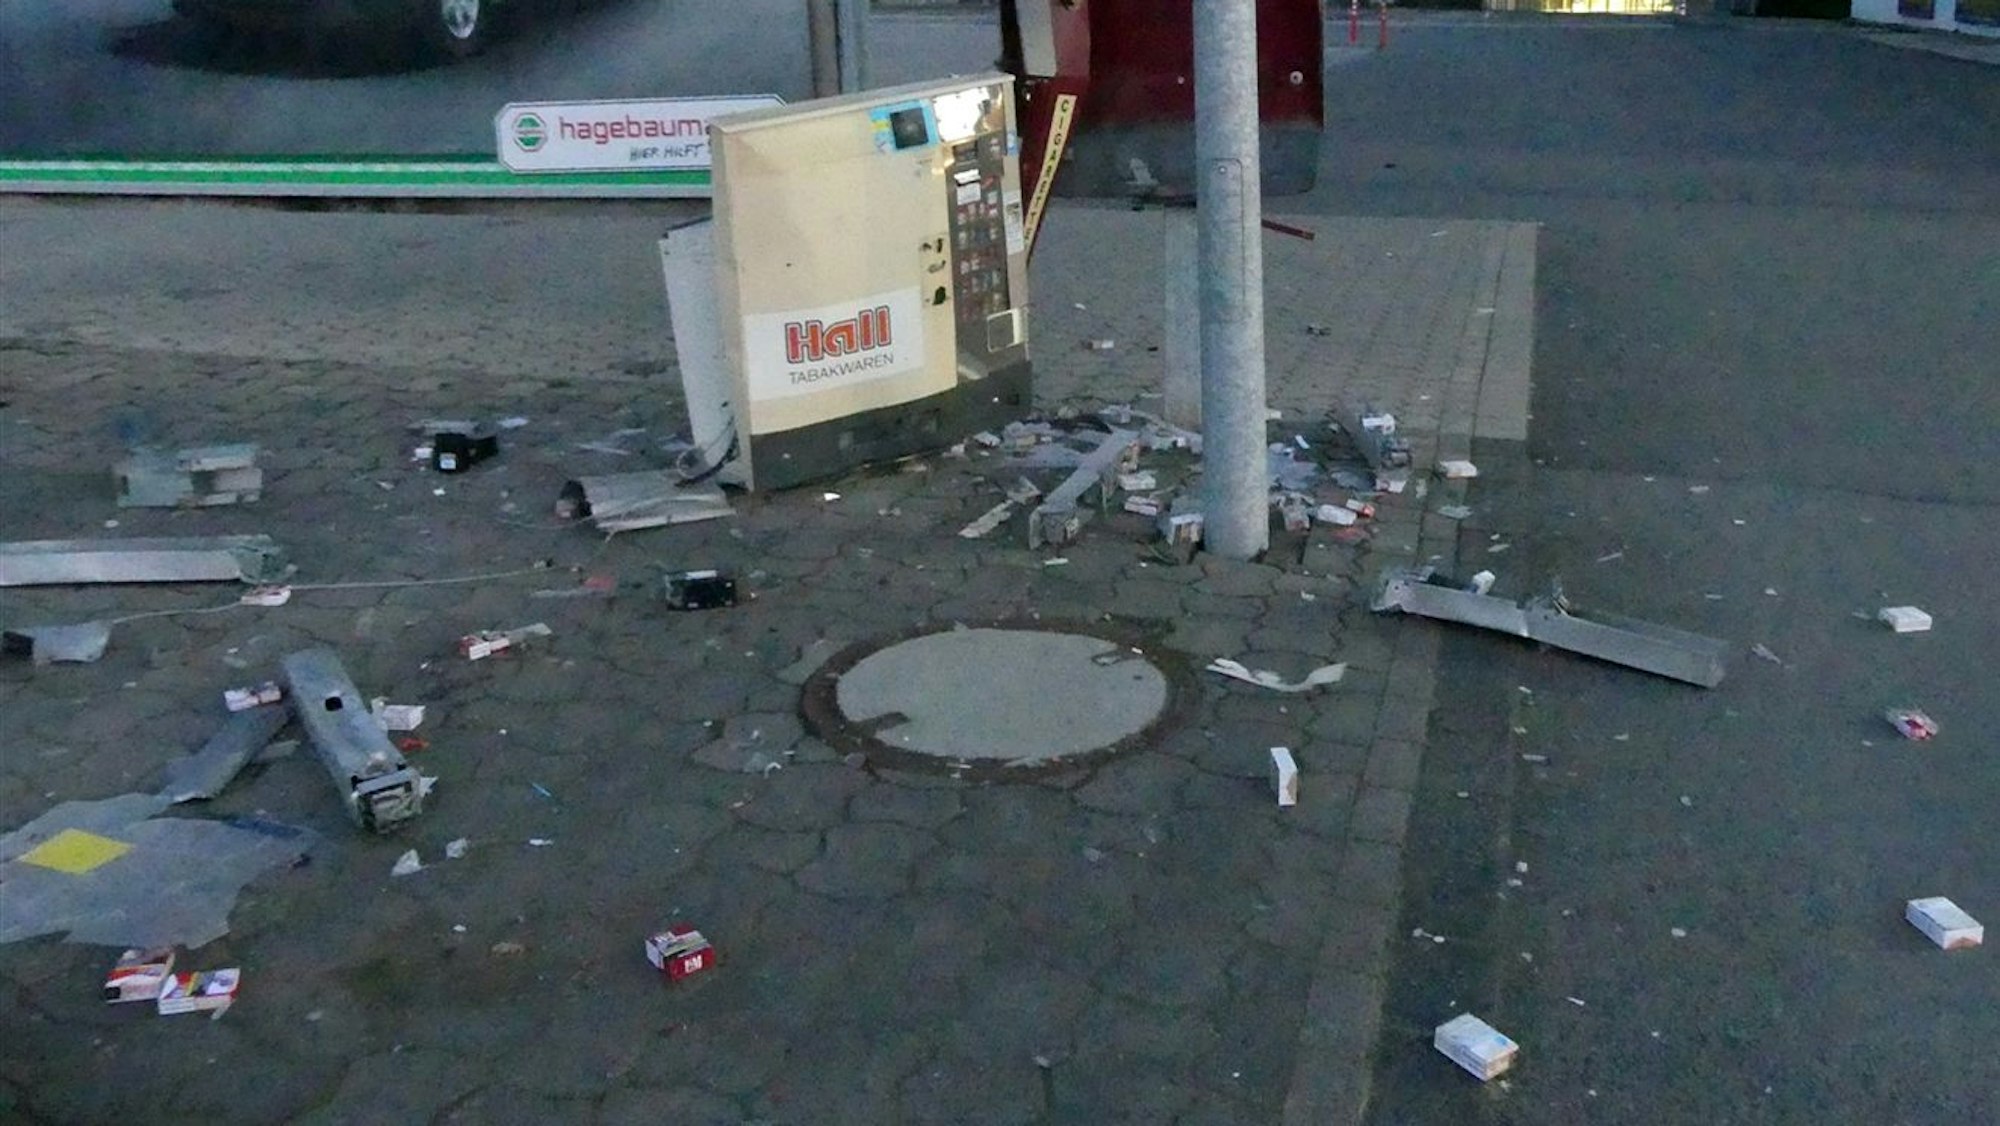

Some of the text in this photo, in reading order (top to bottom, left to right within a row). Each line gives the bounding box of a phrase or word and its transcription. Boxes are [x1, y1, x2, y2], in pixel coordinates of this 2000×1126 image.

[1023, 99, 1070, 251] CIGARETTE
[785, 305, 892, 364] Hall
[788, 353, 894, 385] TABAKWAREN
